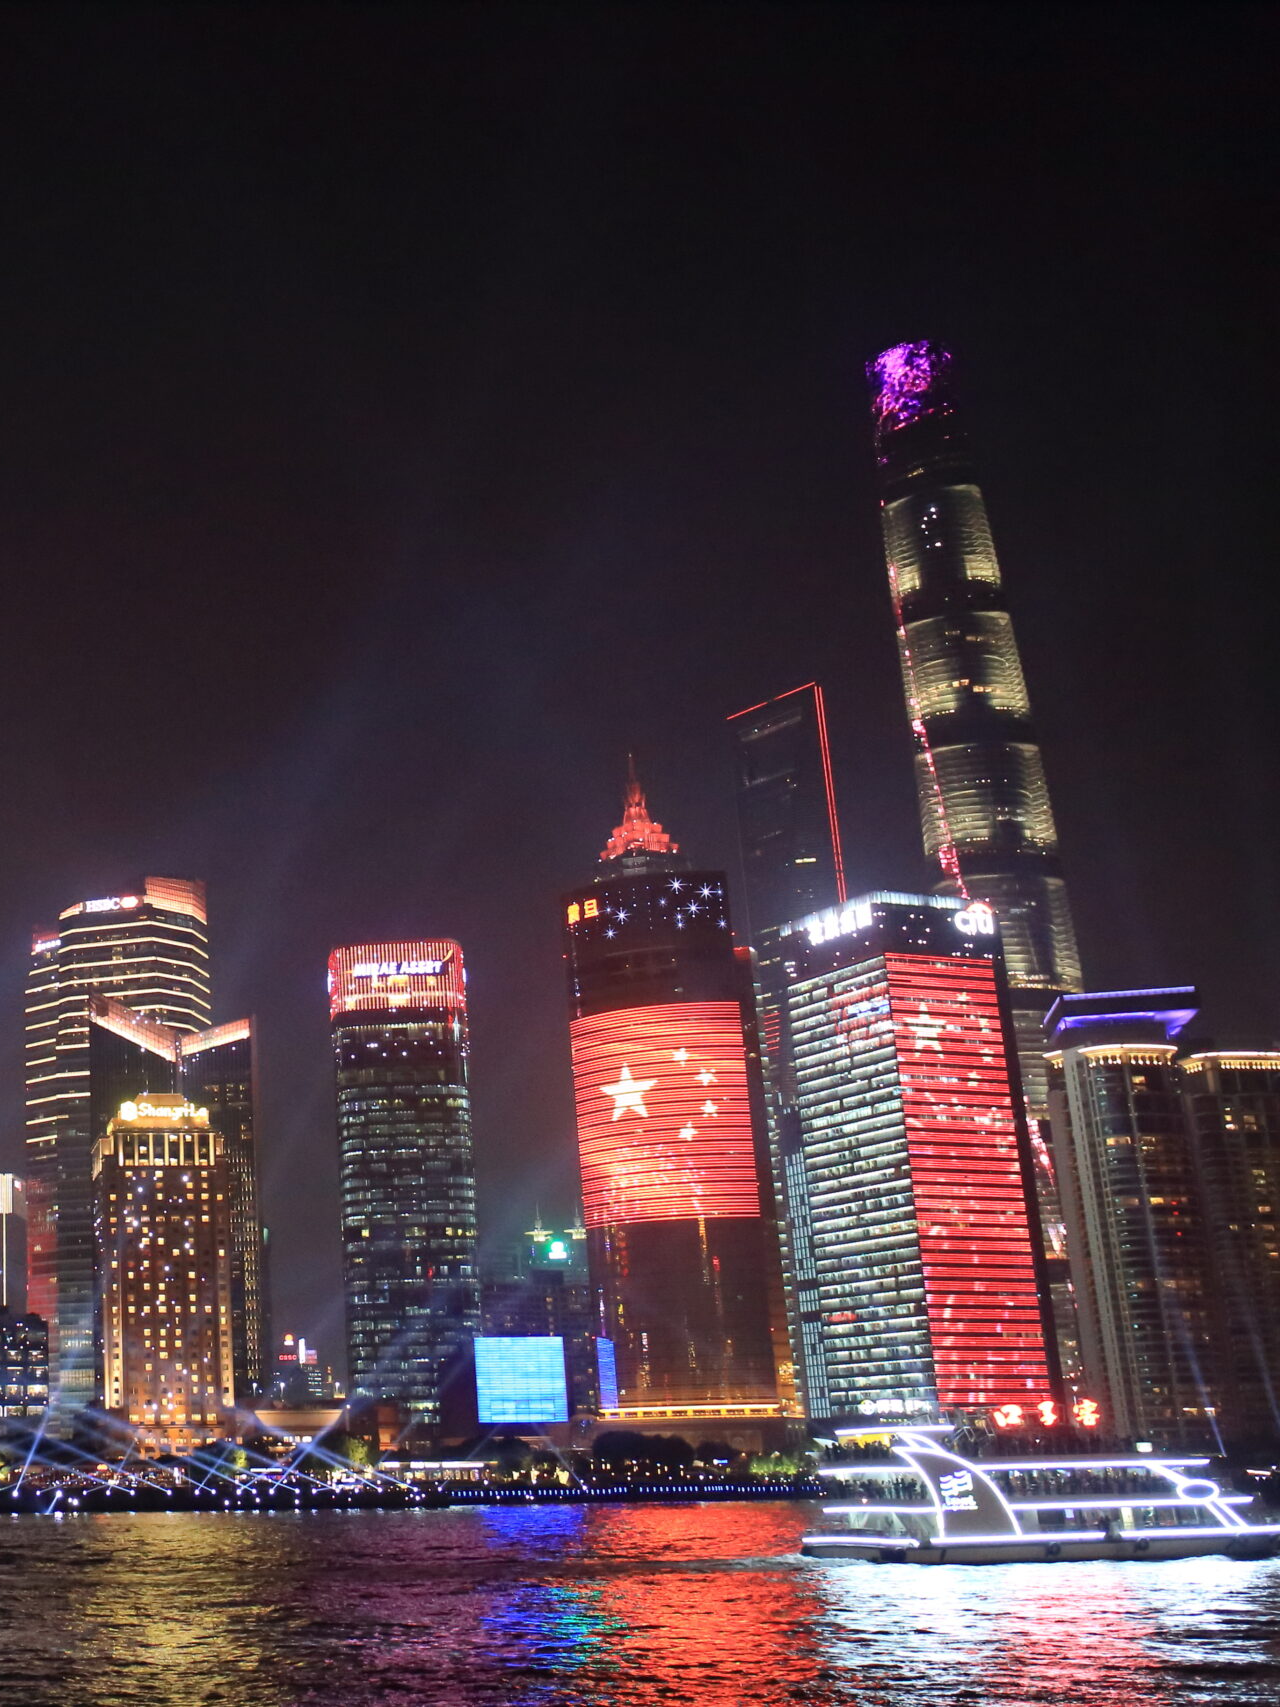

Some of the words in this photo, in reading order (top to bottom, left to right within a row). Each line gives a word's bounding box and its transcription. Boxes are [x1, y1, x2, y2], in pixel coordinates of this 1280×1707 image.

[86, 898, 120, 912] HSBC
[954, 907, 994, 935] citi
[400, 960, 443, 975] ASSET
